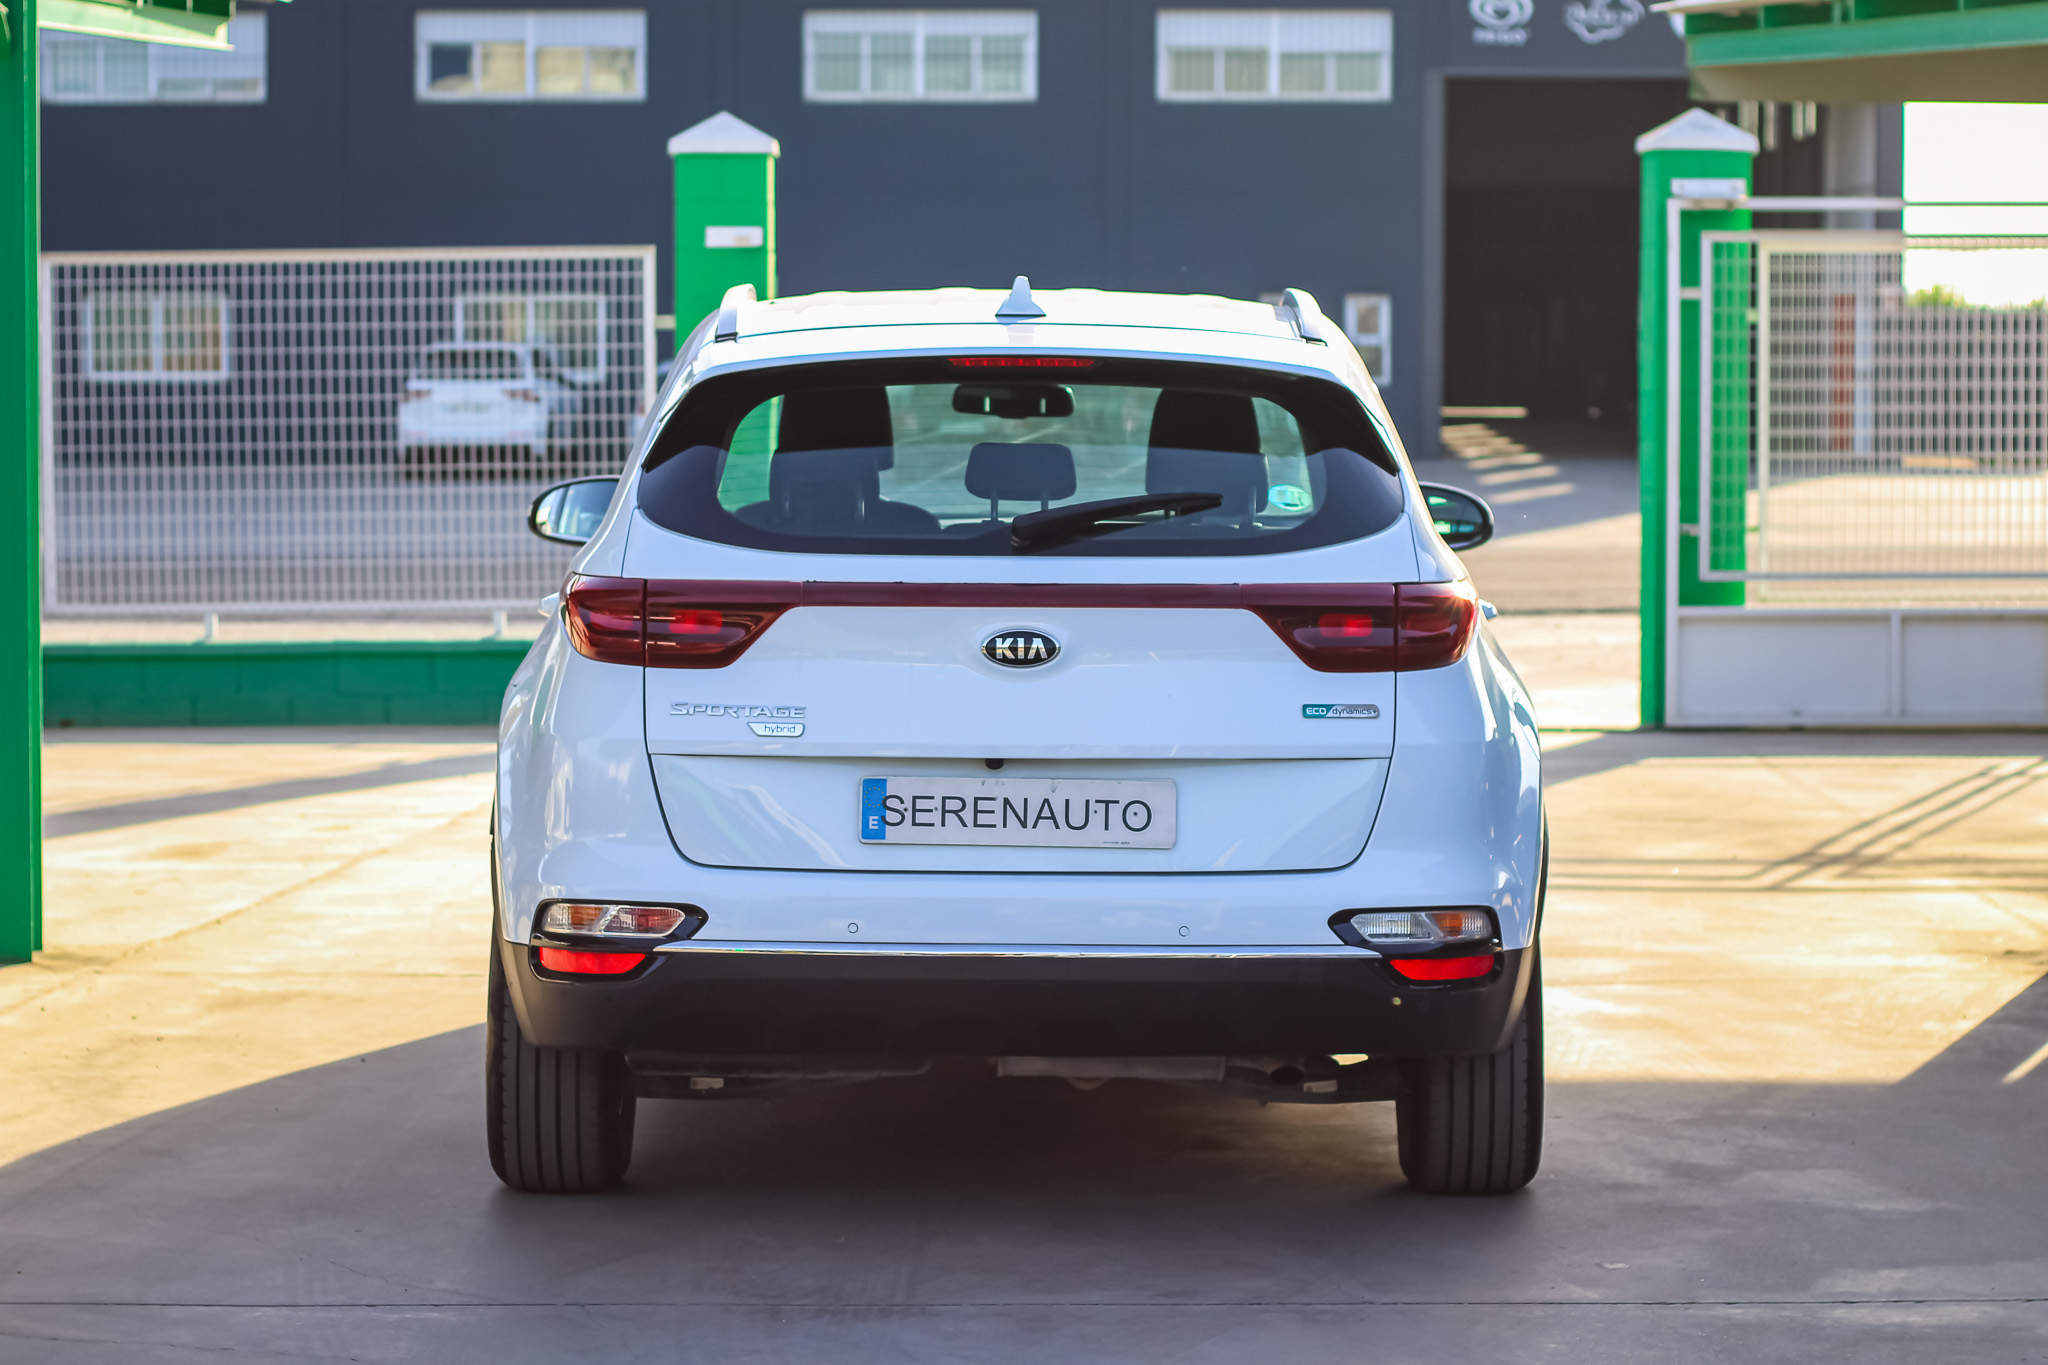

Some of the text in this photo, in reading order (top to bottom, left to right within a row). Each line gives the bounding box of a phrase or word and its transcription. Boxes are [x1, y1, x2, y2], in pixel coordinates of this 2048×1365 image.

[995, 637, 1048, 659] KIA
[669, 702, 806, 718] SPORTAGE
[1306, 707, 1327, 715] ECO
[764, 724, 796, 734] hybrid
[880, 794, 1152, 832] SERENAUTO
[868, 816, 879, 830] E
